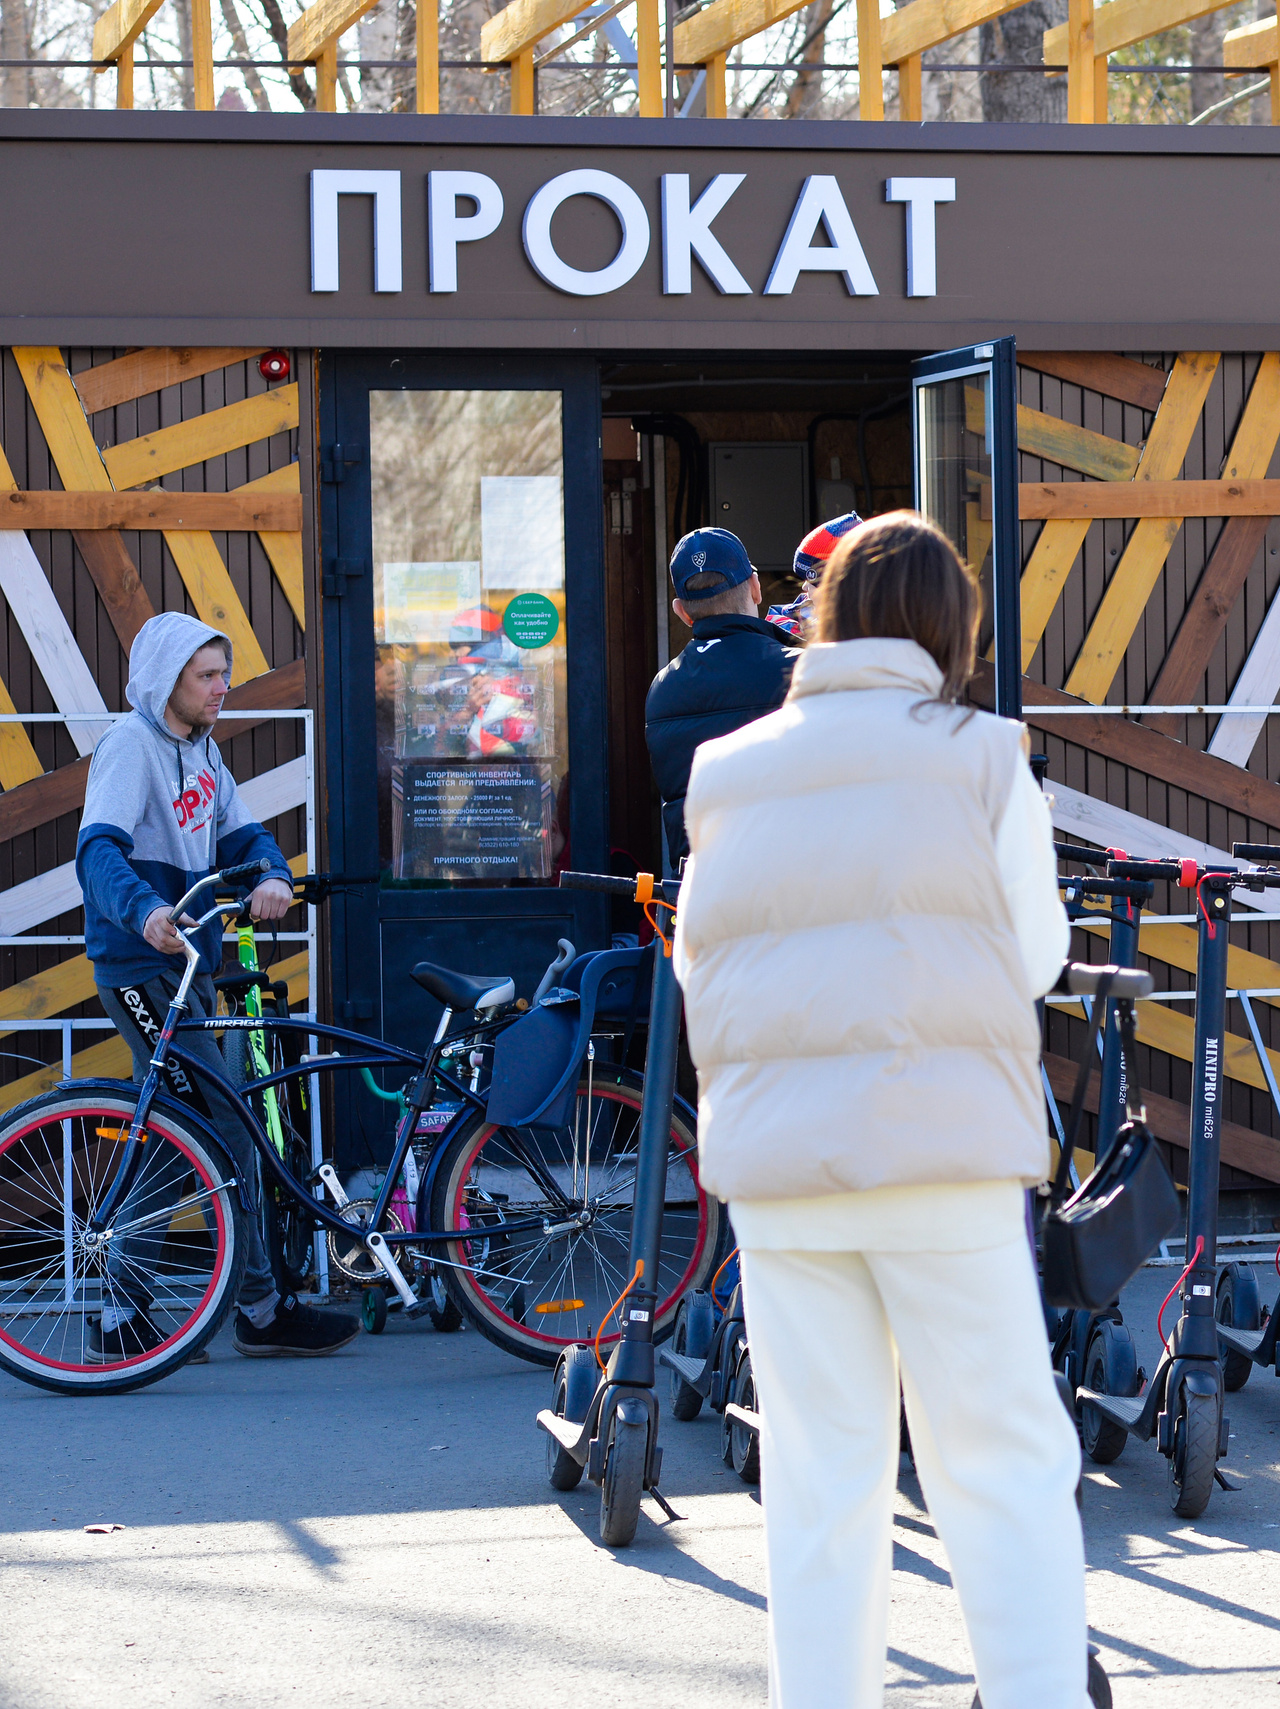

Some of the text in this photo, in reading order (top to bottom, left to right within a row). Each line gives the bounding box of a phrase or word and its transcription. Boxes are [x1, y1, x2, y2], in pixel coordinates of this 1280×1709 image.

[309, 168, 957, 298] ПРОКАТ
[526, 619, 548, 627] удобно
[426, 771, 522, 779] СПОРТИВНЫЙ ИНВЕНТАРЬ
[415, 779, 537, 787] ВЫДАЕТСЯ ПРИ ПРЕДЪЯВЛЕНИИ:
[434, 856, 518, 865] ПРИЯТНОГО ОТДЫХА!
[204, 1019, 265, 1028] MIRAGE
[1203, 1037, 1218, 1139] MINIPRO mi626
